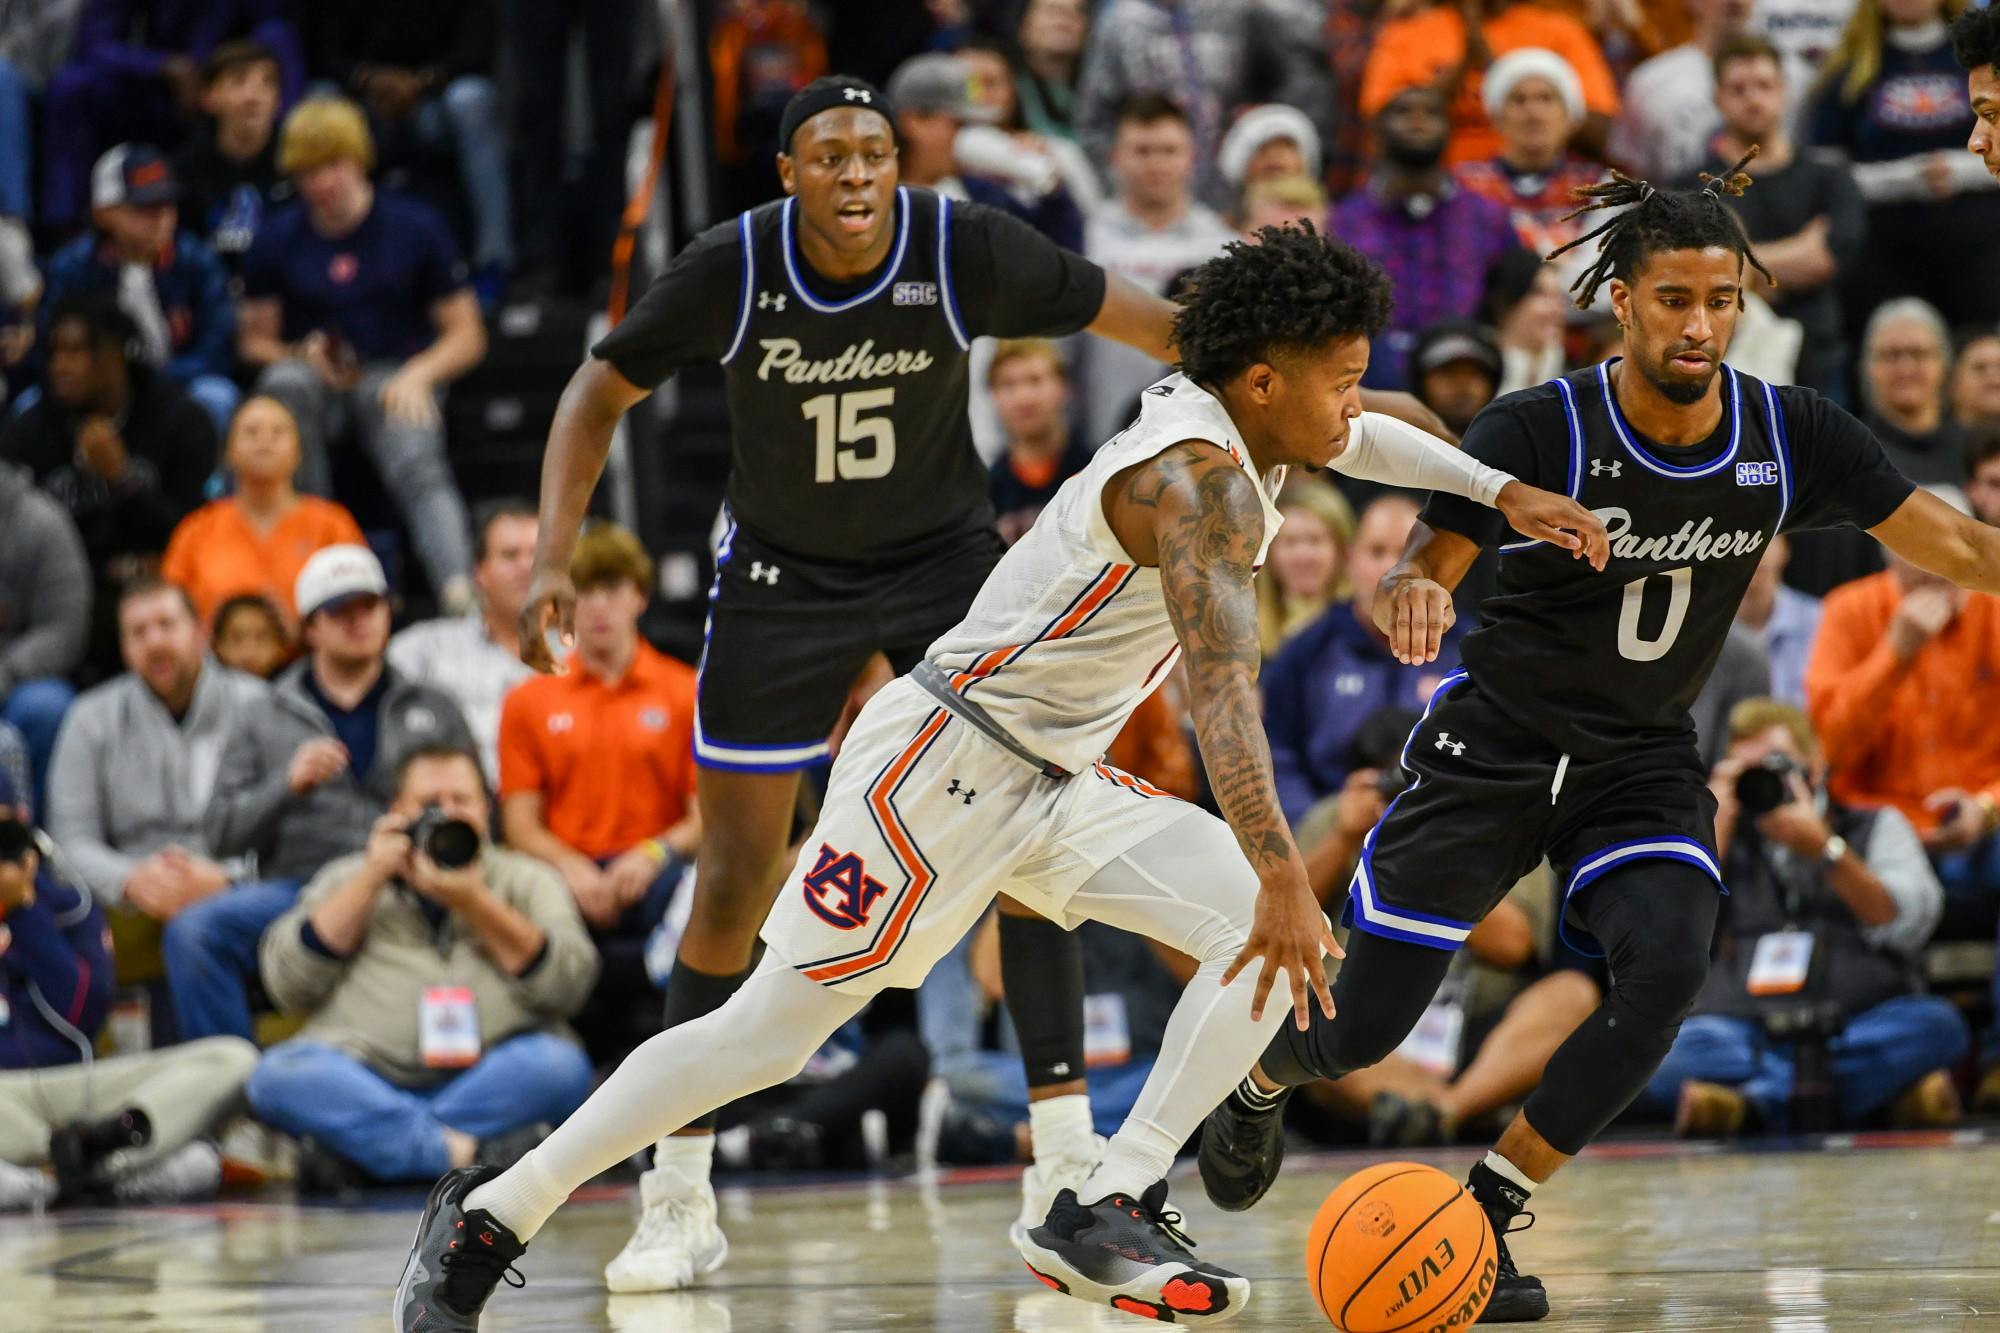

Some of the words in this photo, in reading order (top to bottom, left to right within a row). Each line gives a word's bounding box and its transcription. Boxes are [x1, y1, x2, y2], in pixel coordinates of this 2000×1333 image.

[757, 338, 934, 384] Panthers
[802, 387, 896, 484] 15
[1736, 461, 1778, 487] SBC
[1590, 506, 1764, 562] Panthers
[1617, 566, 1693, 662] 0
